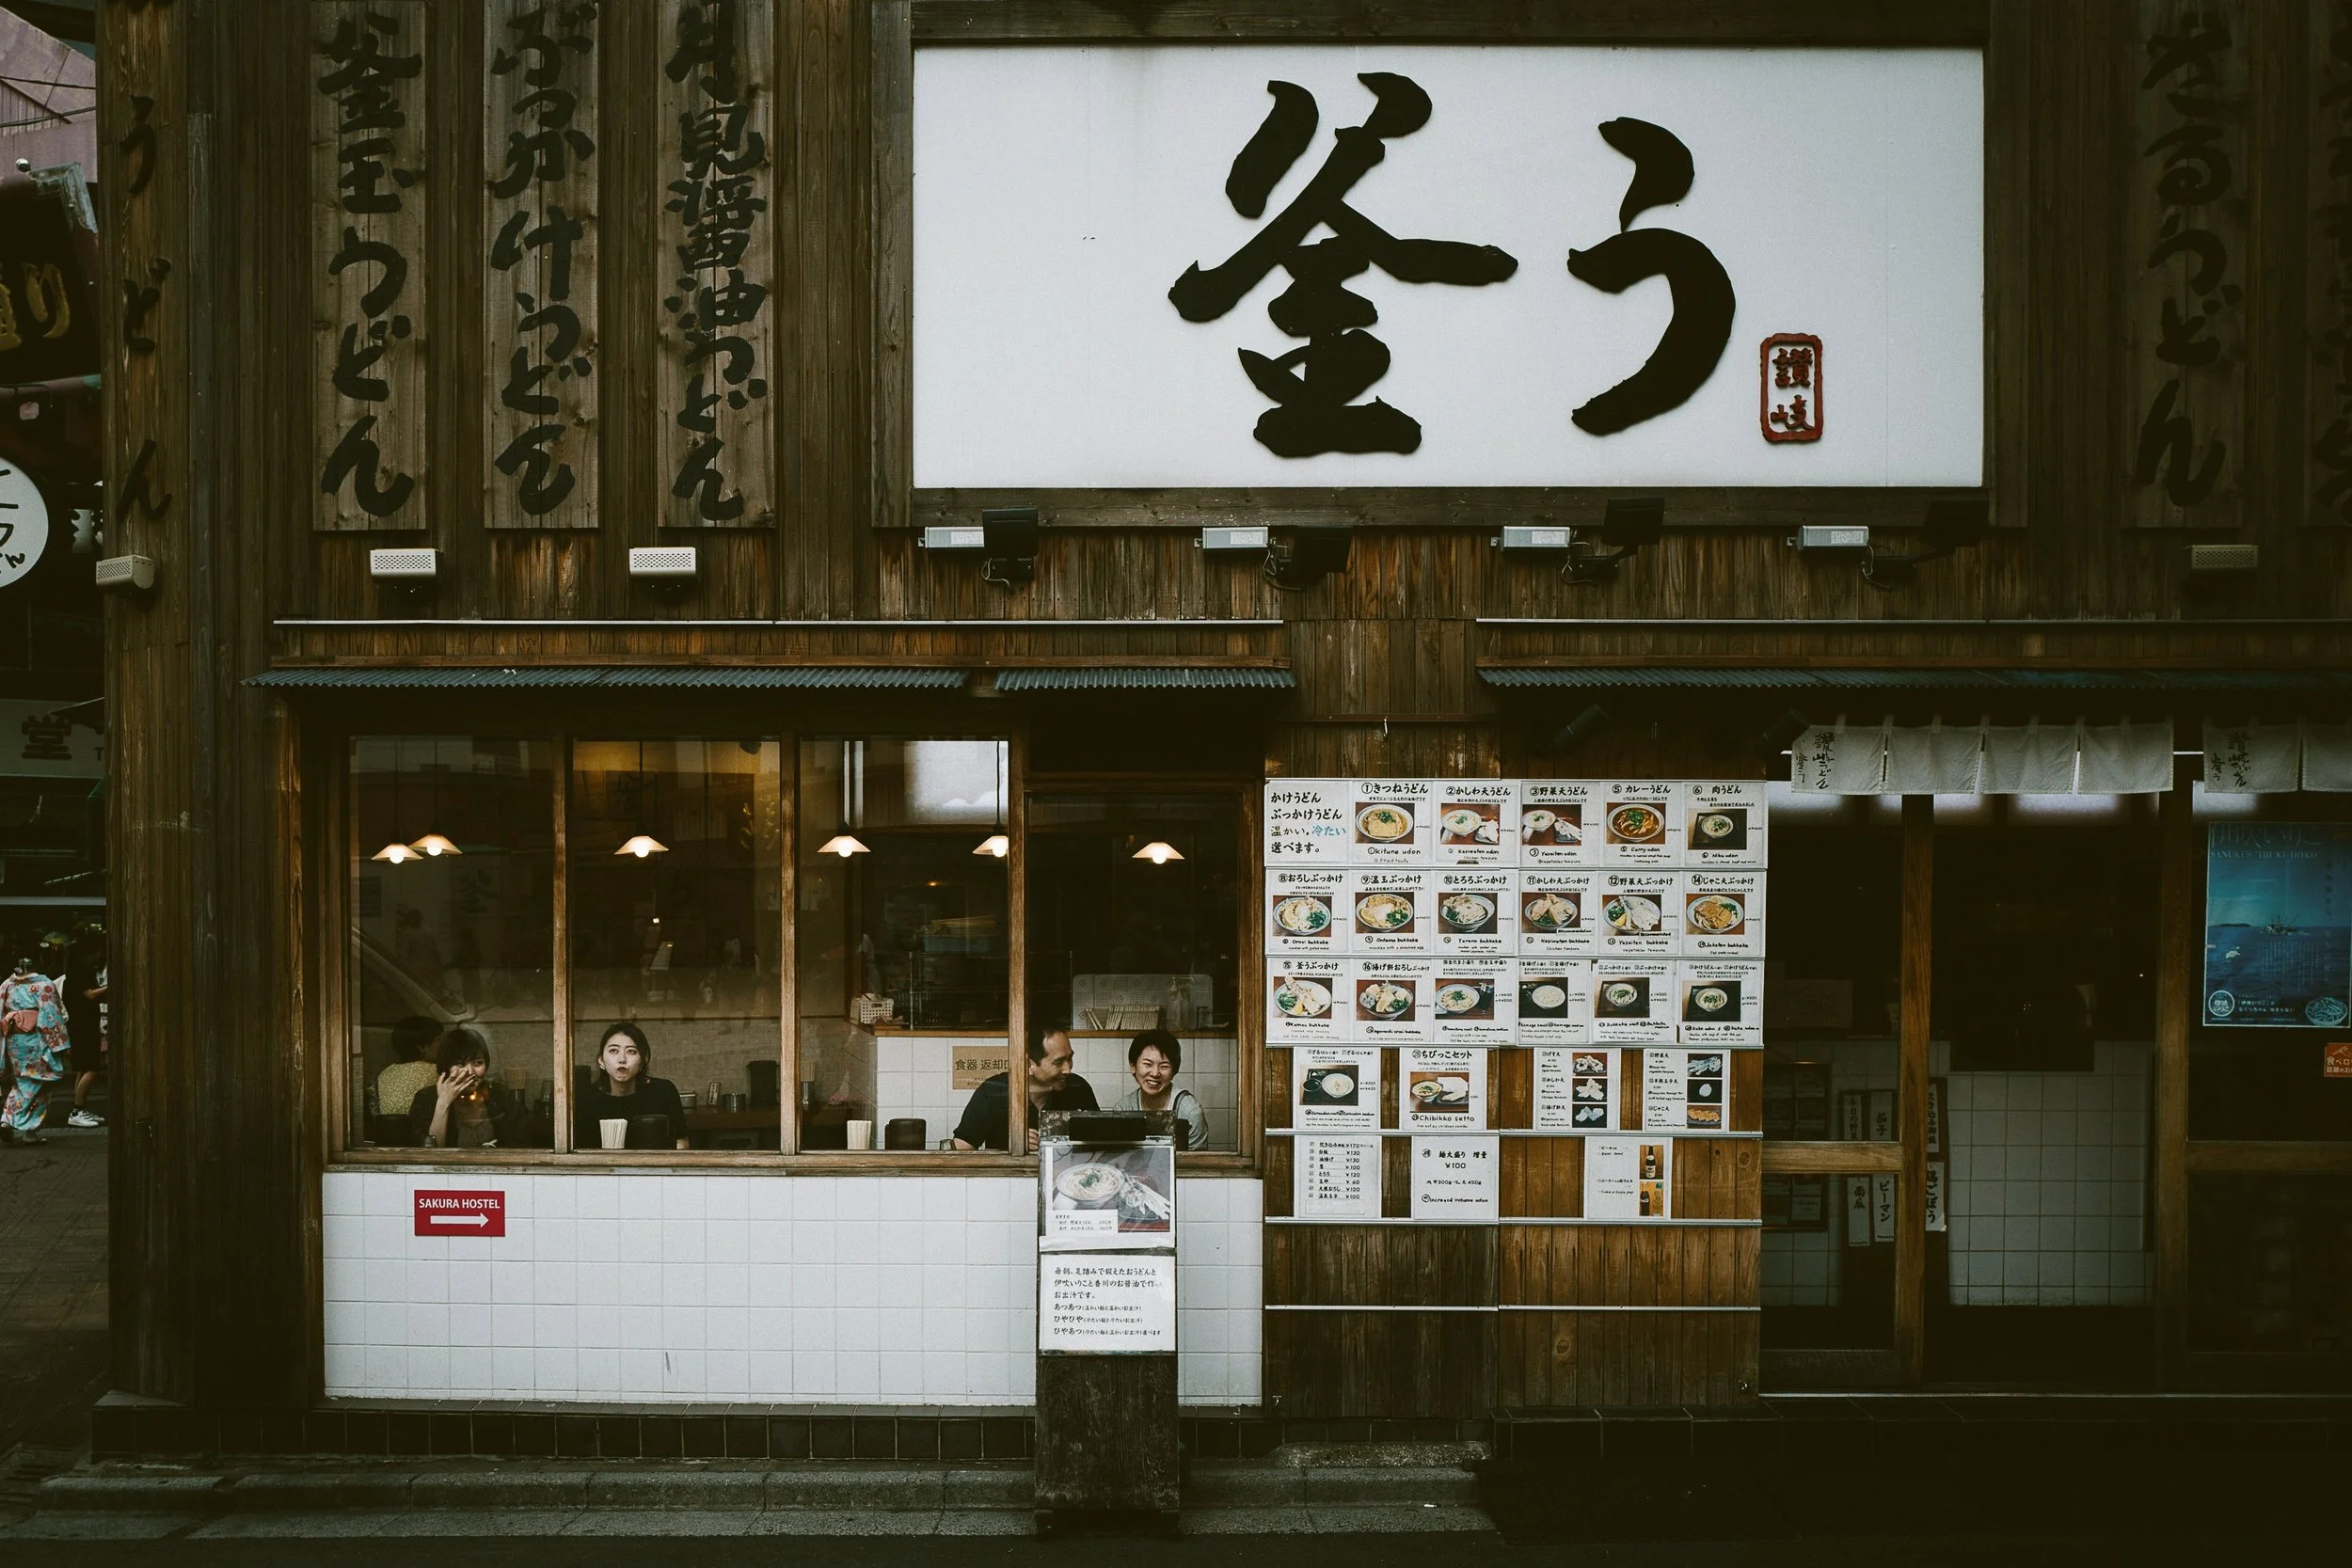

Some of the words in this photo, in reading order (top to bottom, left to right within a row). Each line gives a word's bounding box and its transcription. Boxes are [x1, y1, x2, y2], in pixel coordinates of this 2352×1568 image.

[2137, 9, 2243, 507] ざるうどん
[317, 10, 422, 517] 釜玉うどん
[1361, 782, 1429, 794] ①きつねうどん
[1446, 786, 1511, 796] ②かしわ天うどん
[1530, 786, 1587, 796] ③野菜天うどん
[1626, 784, 1671, 794] カレーうどん
[1712, 784, 1741, 794] 肉うどん
[1271, 792, 1321, 803] かけうどん
[1271, 809, 1342, 819] ぶっかけうどん
[1271, 842, 1319, 853] 選べます。
[1279, 874, 1343, 882] ⑧おろしぶっかけ
[1361, 875, 1422, 884] ⑨温玉ぶっかけ
[1444, 876, 1506, 884] ⑩とろろぶっかけ
[1527, 876, 1589, 884] ⑪かしわ天ぶっかけ
[1608, 876, 1673, 886] ⑫野菜天ぶっかけ
[1692, 874, 1754, 885] ⑭じゃこ天ぶっかけ
[1296, 961, 1338, 970] 釜うぶっかけ
[956, 1059, 977, 1070] 食器
[2327, 1056, 2352, 1066] 食べロ
[1454, 1113, 1474, 1121] setto
[419, 1197, 459, 1209] SAKURA
[461, 1198, 501, 1209] HOSTEL
[1853, 1186, 1866, 1210] 南瓜
[1880, 1180, 1890, 1223] ピーマン
[1054, 1291, 1095, 1299] お出汁です。
